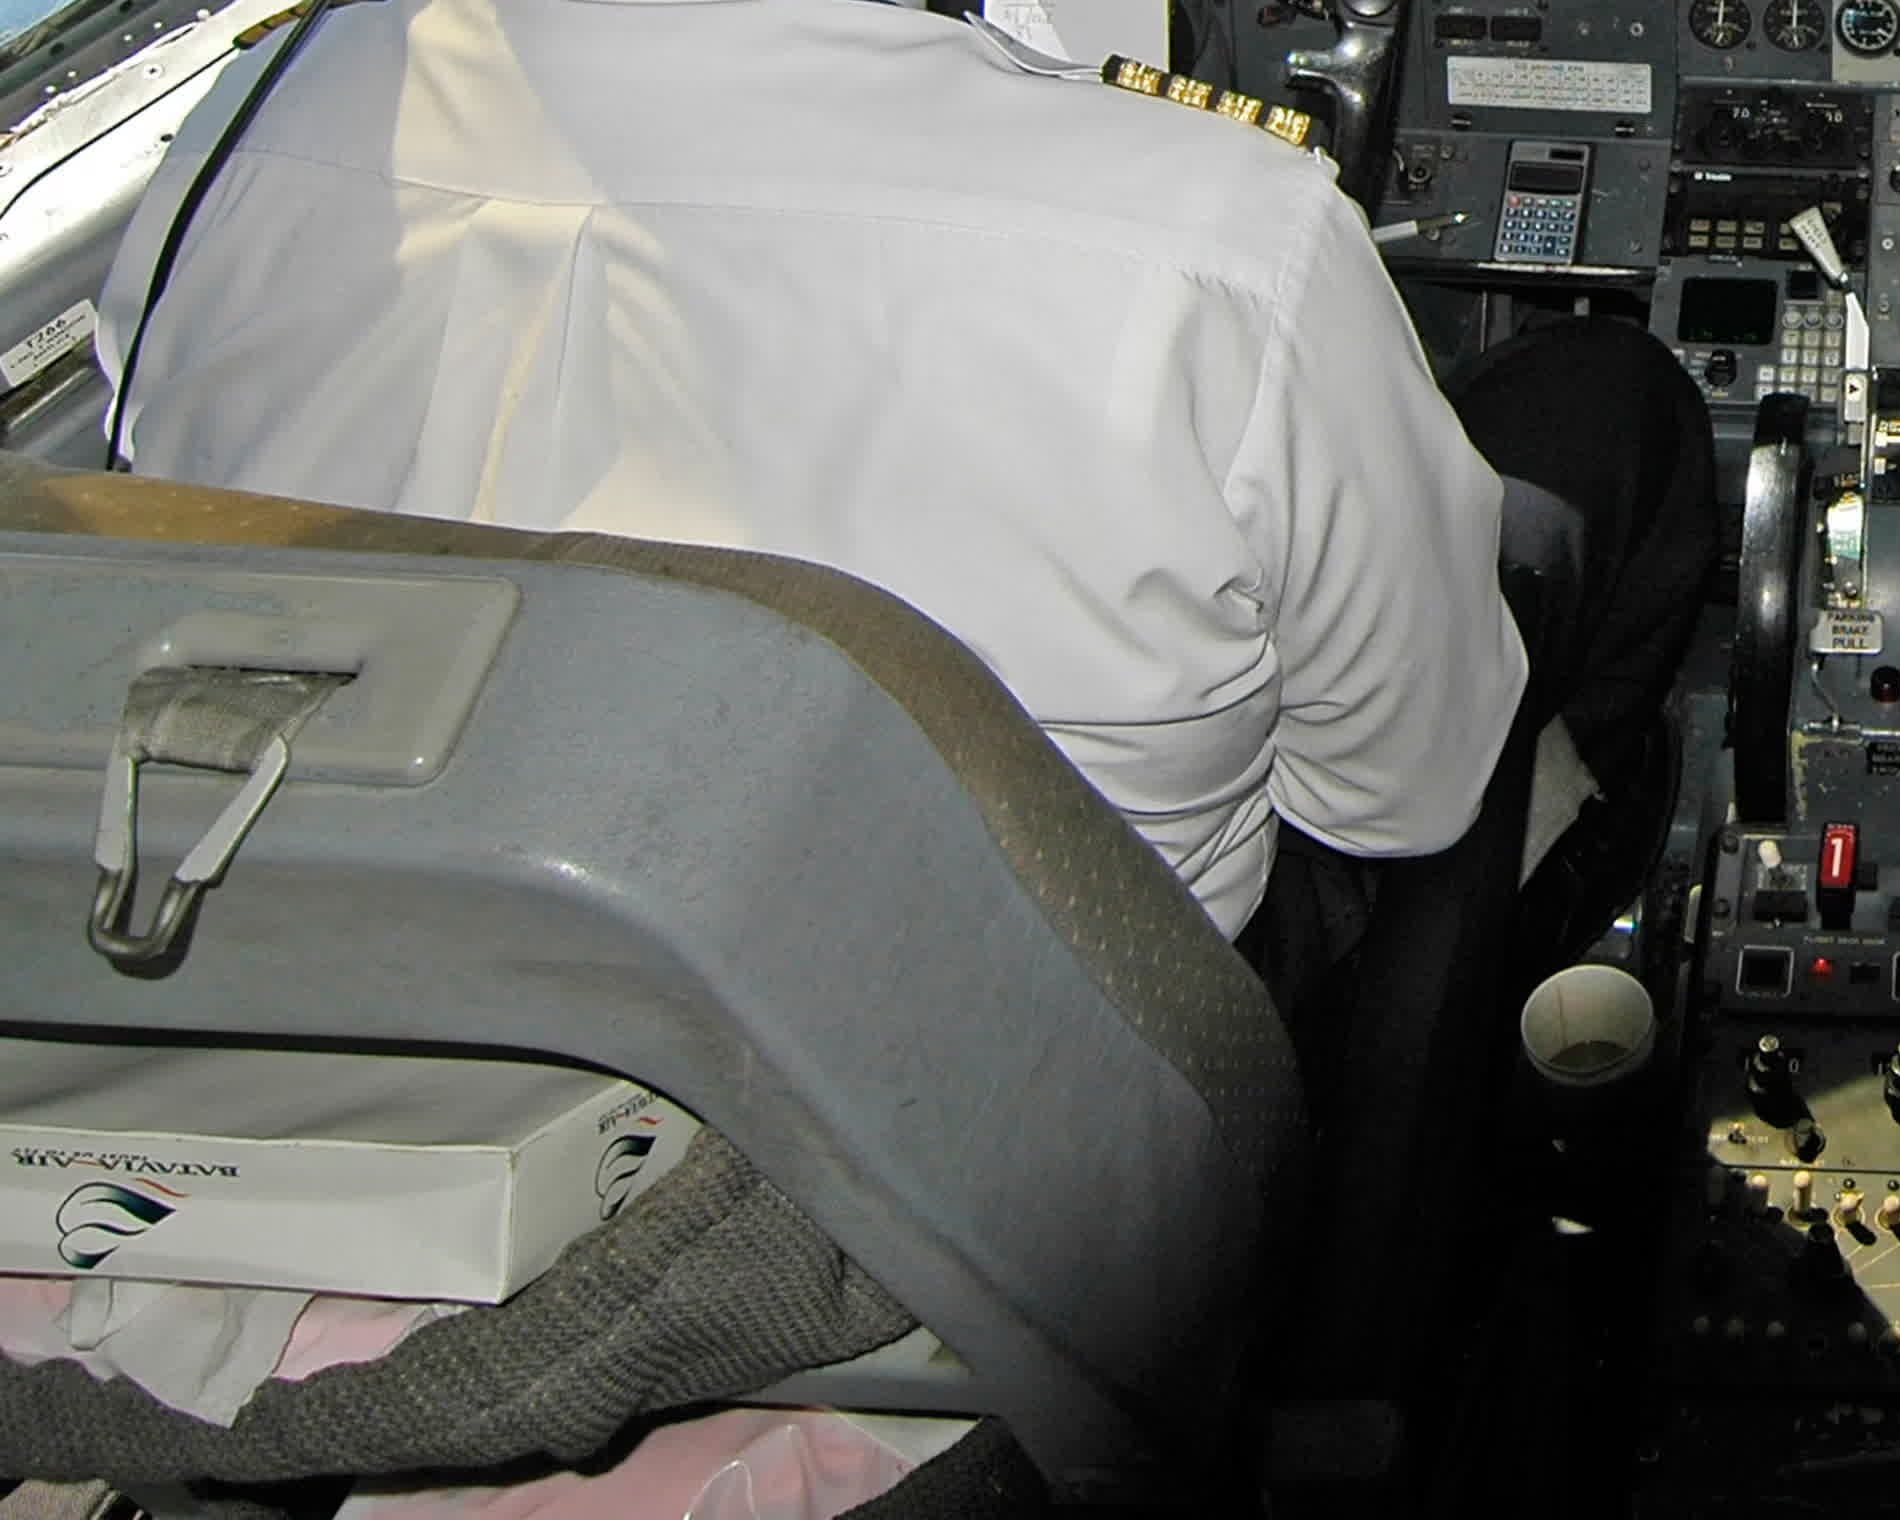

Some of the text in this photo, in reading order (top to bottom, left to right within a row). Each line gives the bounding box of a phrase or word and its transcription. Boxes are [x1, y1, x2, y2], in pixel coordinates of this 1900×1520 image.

[1832, 638, 1867, 650] PULL
[1831, 837, 1843, 878] 1
[11, 1150, 241, 1178] BATAVIA AIR
